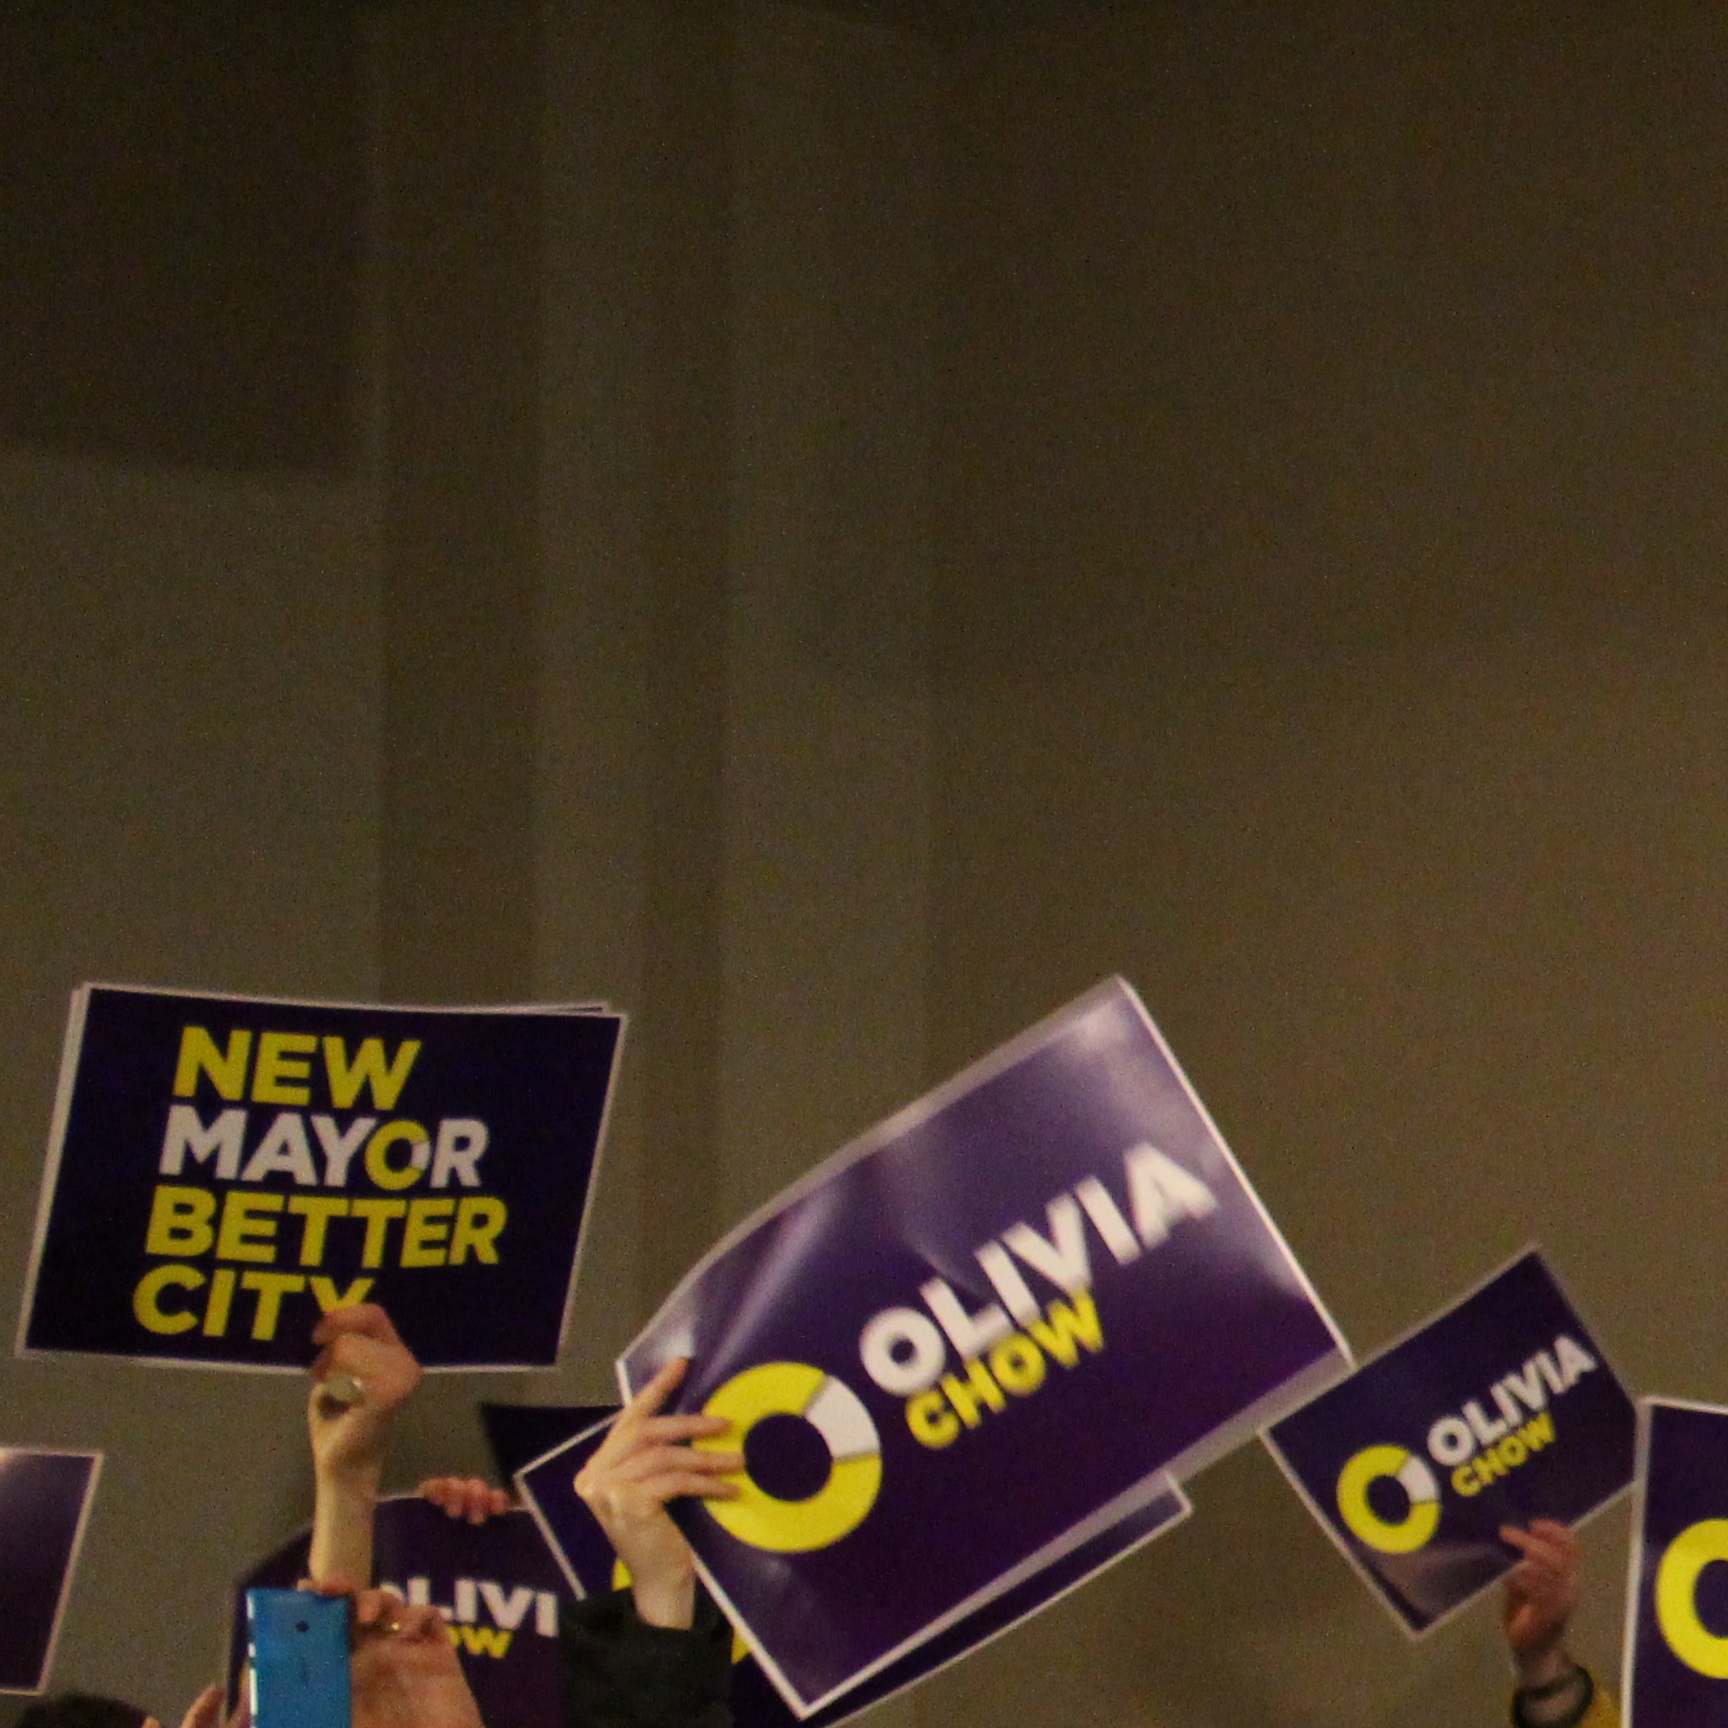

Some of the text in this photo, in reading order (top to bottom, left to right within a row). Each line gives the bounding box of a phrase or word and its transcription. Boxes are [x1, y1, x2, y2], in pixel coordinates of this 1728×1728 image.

[172, 1025, 423, 1111] NEW
[158, 1104, 489, 1191] MAYOR
[145, 1184, 508, 1269] BETTER
[859, 1141, 1220, 1396] OLIVIA
[905, 1287, 1104, 1450] CHOW
[1427, 1334, 1597, 1468] OLIVIA
[1450, 1411, 1557, 1498] CHOW
[379, 1576, 560, 1638] LIVI
